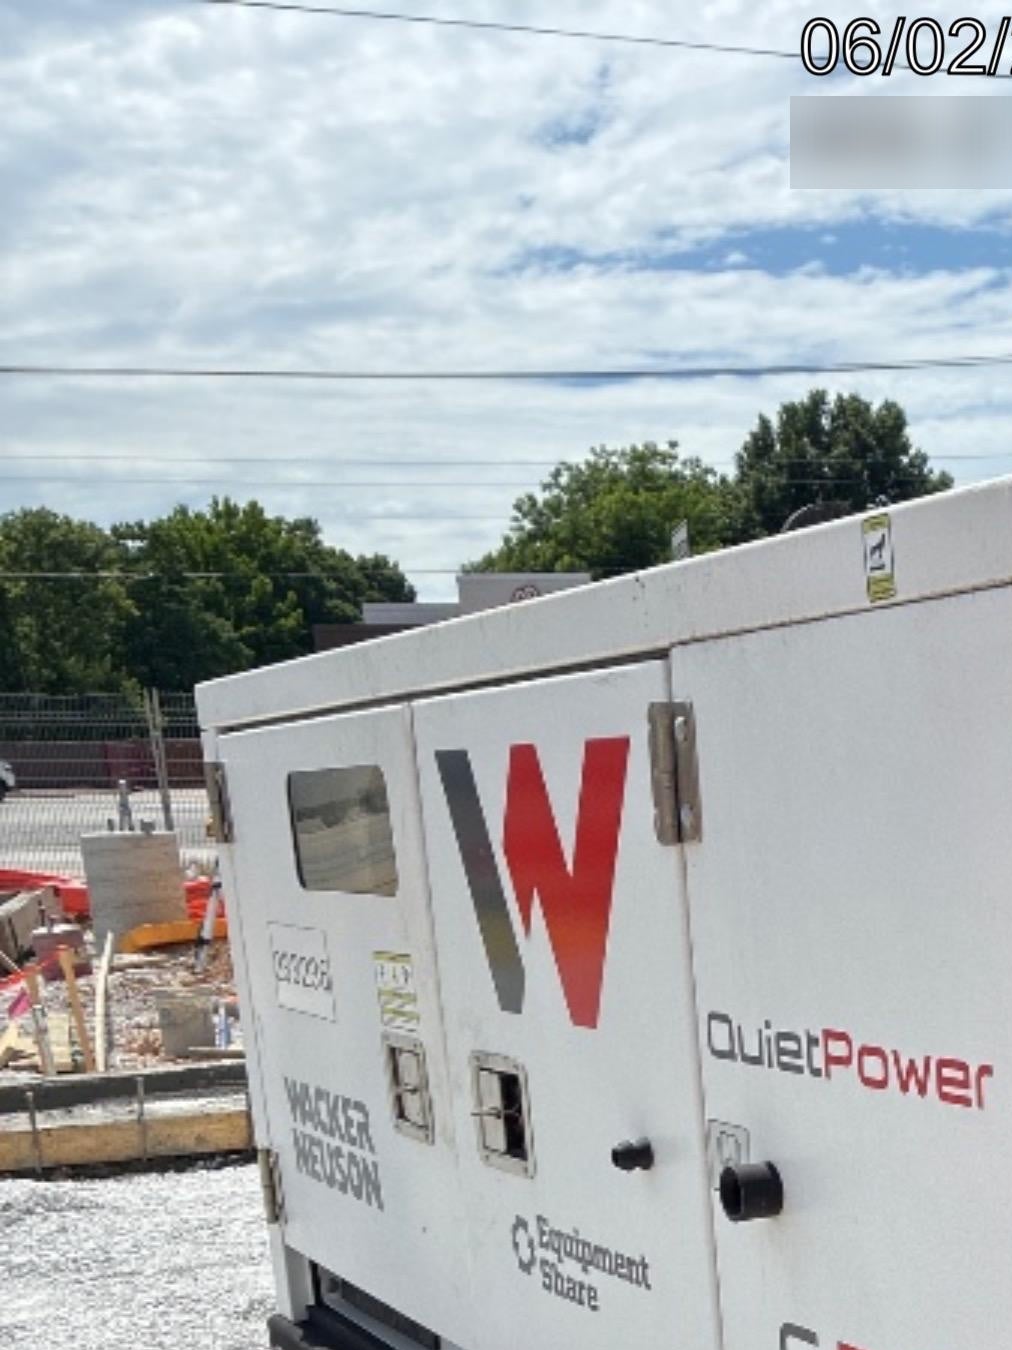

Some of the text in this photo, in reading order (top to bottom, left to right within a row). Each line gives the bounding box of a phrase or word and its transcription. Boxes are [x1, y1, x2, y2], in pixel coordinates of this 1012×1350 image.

[706, 1010, 995, 1110] QuietPower
[283, 1076, 376, 1155] WACKER
[292, 1127, 385, 1213] NEUSON
[535, 1214, 652, 1291] Equipment
[539, 1257, 600, 1312] Share
